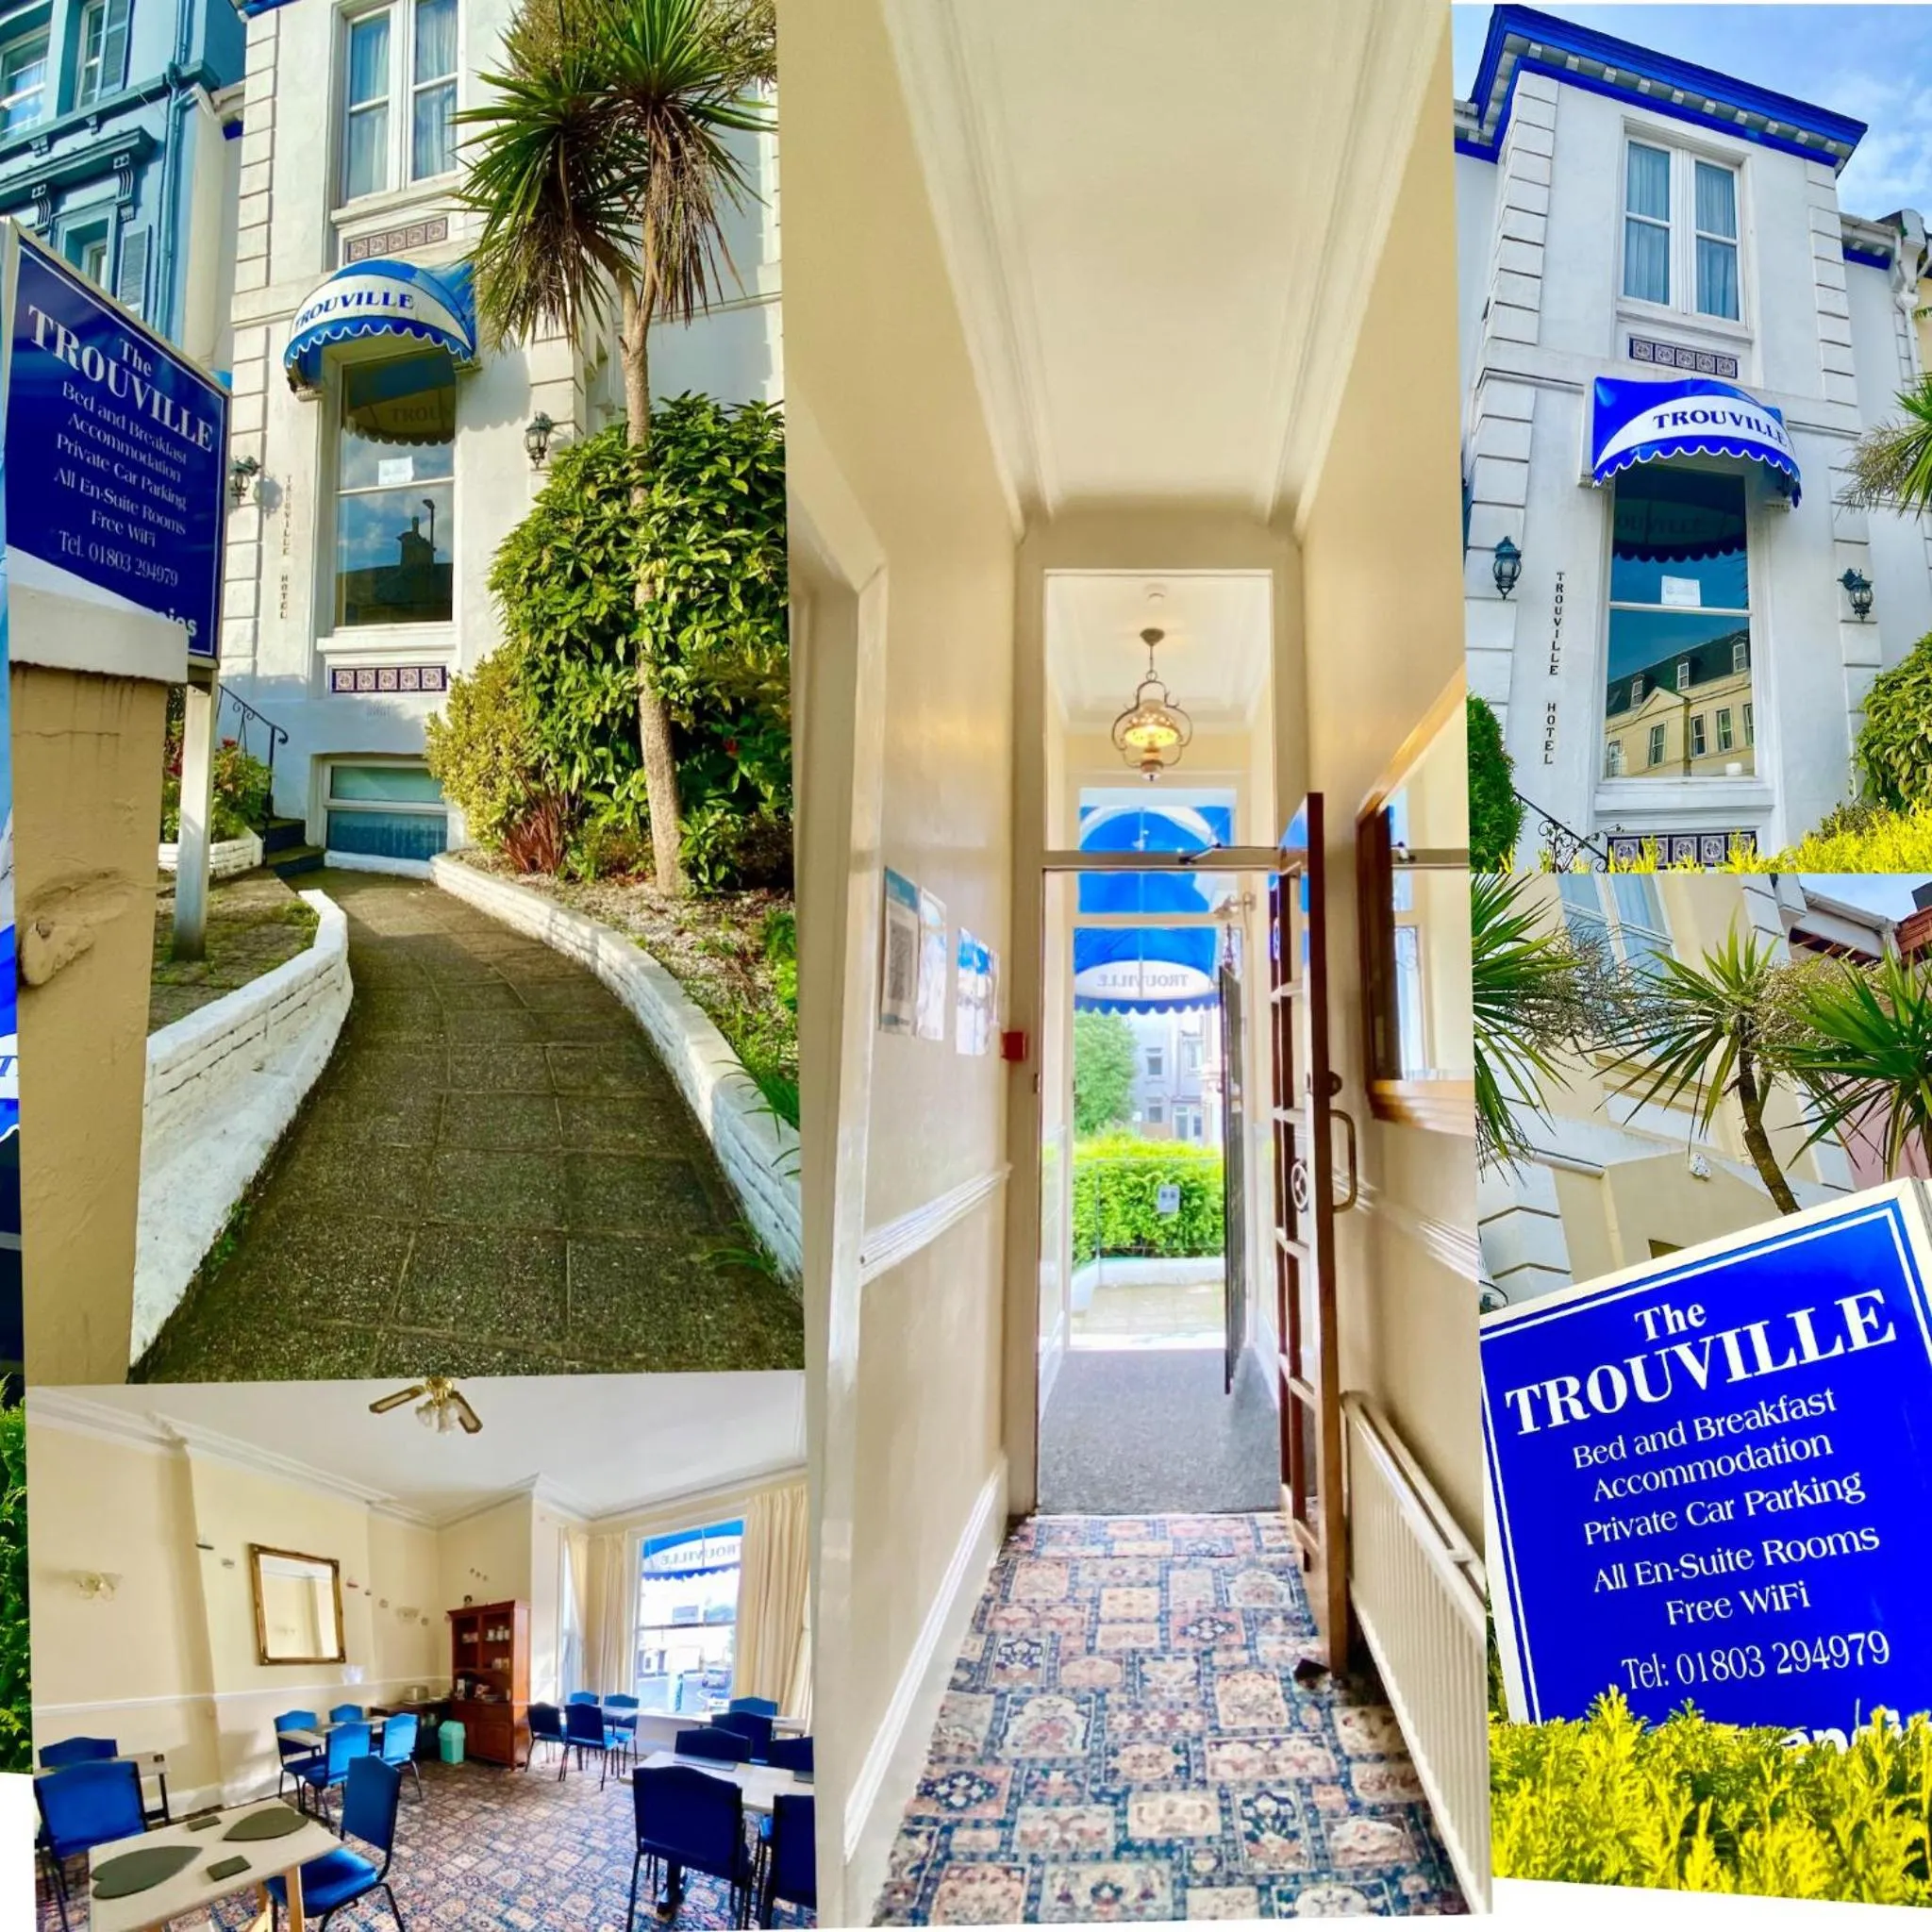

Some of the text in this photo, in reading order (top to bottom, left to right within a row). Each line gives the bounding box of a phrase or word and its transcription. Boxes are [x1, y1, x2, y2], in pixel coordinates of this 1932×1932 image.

[28, 304, 214, 453] TROUVILLE
[119, 338, 152, 377] The
[62, 380, 187, 465] Bed and Breakfast
[68, 412, 181, 483] Accommodation
[1653, 408, 1787, 447] TROUVILLE
[54, 467, 186, 535] All En-Suite Rooms
[57, 433, 187, 512] Private Car Parking
[92, 509, 157, 548] Free WiFi
[89, 542, 132, 574] 01803
[135, 558, 179, 588] 294979
[1543, 571, 1565, 765] TROUVILLE HOTEL
[1634, 1300, 1707, 1341] The
[1504, 1288, 1898, 1437] TROUVILLE
[1573, 1387, 1839, 1469] Bed and Breakfast
[1593, 1433, 1835, 1503] Accommodation
[1583, 1472, 1867, 1546] Private Car Parking
[1593, 1525, 1881, 1593] All En-Suite Rooms
[1665, 1579, 1811, 1626] Free WiFi
[1621, 1629, 1890, 1690] Tel: 01803 294979
